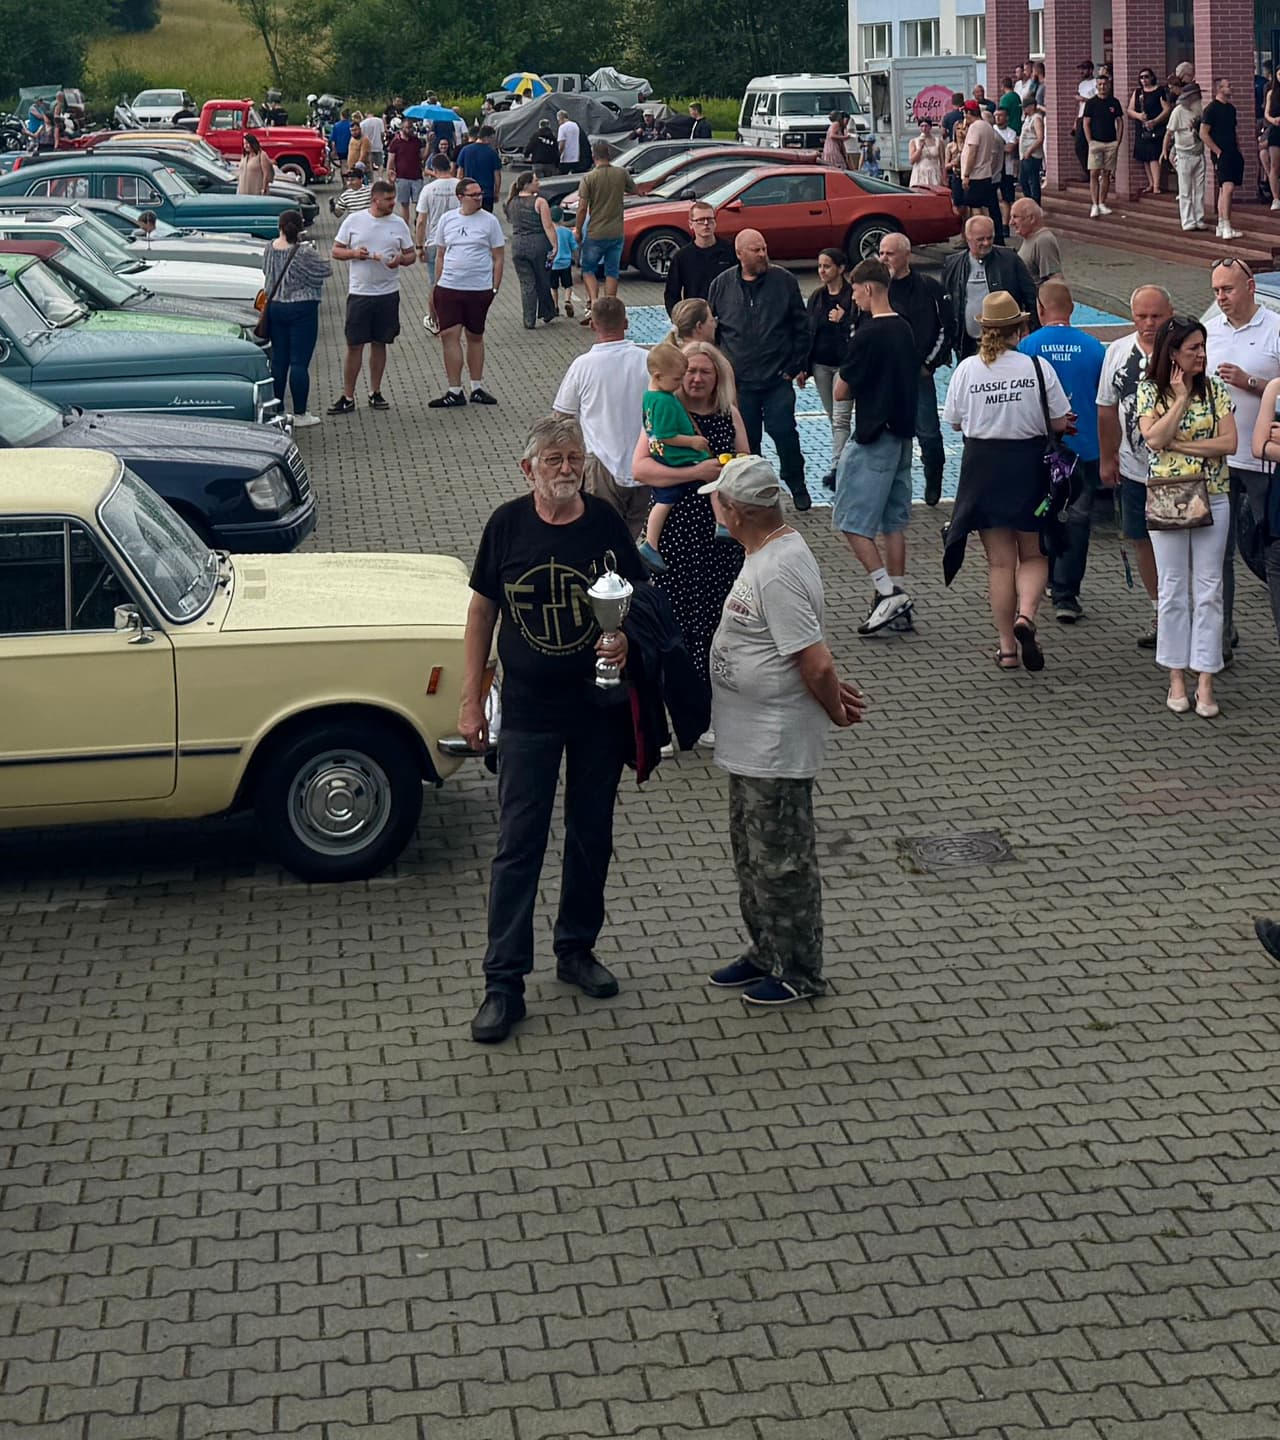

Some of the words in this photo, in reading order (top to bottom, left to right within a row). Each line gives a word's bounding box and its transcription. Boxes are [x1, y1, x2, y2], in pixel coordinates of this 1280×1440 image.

[1041, 344, 1065, 353] CLASSIC
[1065, 344, 1082, 353] CARS
[970, 380, 1008, 394] CLASSIC
[1010, 378, 1035, 389] CARS
[985, 392, 1022, 405] MIELEC
